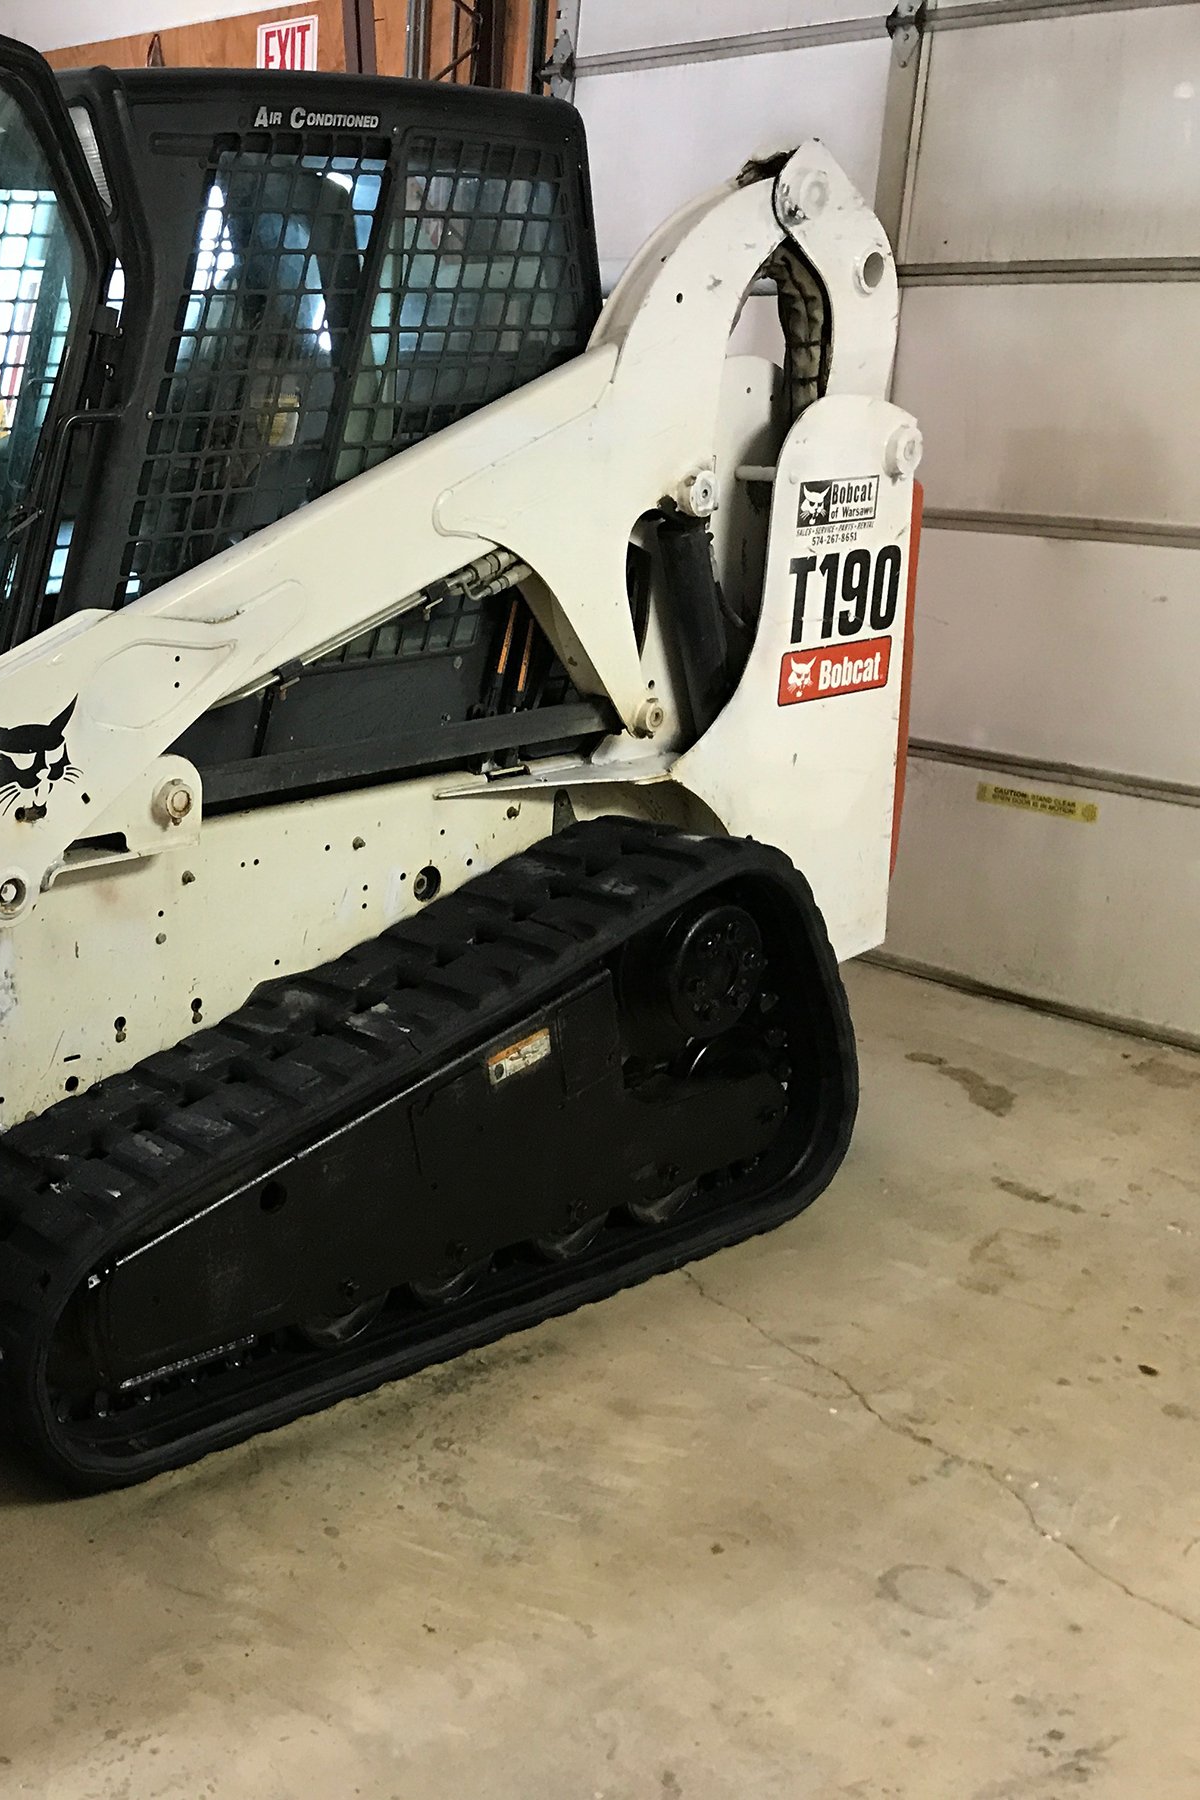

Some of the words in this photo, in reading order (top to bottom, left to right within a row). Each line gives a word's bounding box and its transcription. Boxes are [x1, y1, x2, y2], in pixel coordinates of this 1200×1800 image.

[265, 24, 310, 71] EXIT
[290, 107, 379, 128] CONDITIONED
[831, 482, 873, 505] Bobcat
[830, 507, 839, 519] of
[842, 506, 872, 518] Warsaw
[811, 532, 858, 546] 574-267-8651
[789, 545, 902, 644] T190
[818, 652, 881, 691] Bobcat
